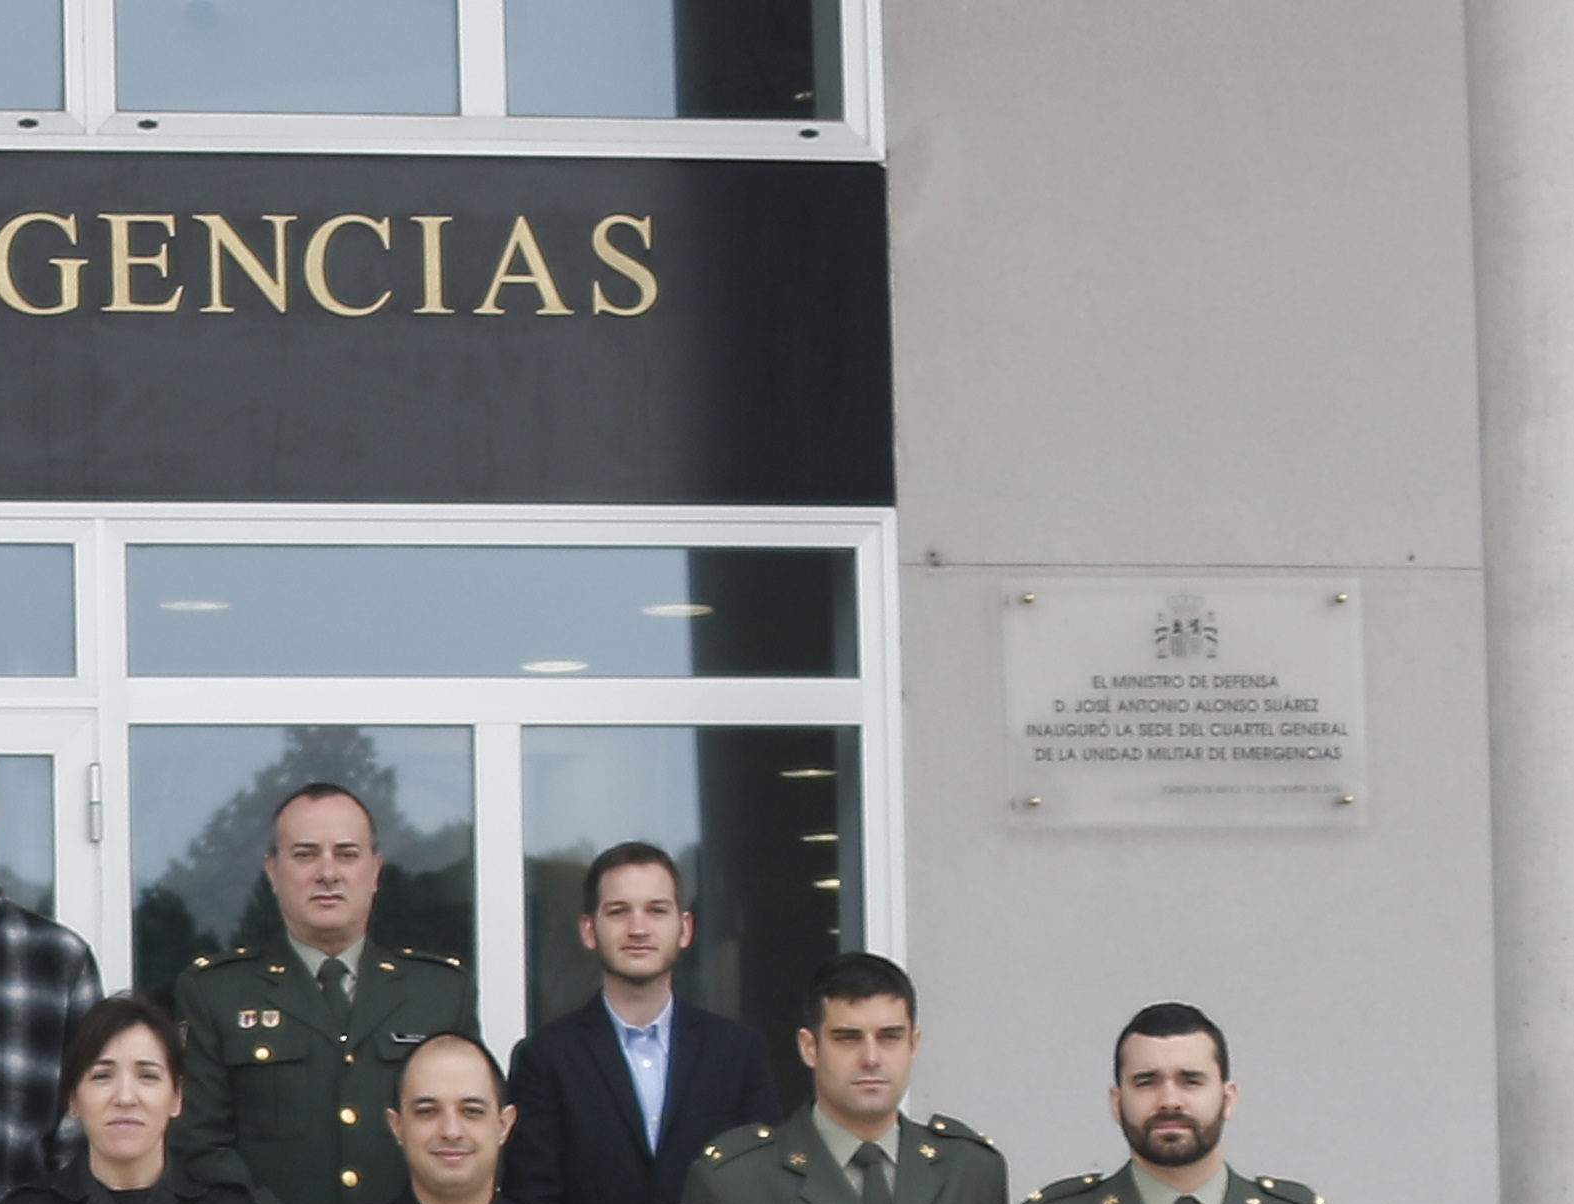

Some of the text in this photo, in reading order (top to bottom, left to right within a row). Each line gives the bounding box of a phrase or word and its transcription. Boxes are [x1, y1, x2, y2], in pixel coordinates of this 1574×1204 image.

[1091, 674, 1280, 689] EL MINISTRO DE DEFENSA
[1074, 695, 1112, 713] JOSÉ
[1117, 699, 1190, 713] ANTONIO
[1195, 699, 1260, 713] ALONSO
[1263, 695, 1320, 713] SUÁREZ
[1115, 724, 1134, 737] LA
[1138, 723, 1174, 737] SEDE
[1179, 723, 1205, 737] DEL
[1210, 723, 1275, 737] CUARTEL
[1279, 723, 1349, 737] GENERAL
[1034, 747, 1343, 762] DE LA UNIDAD MILITAR DE EMERGENCIAS
